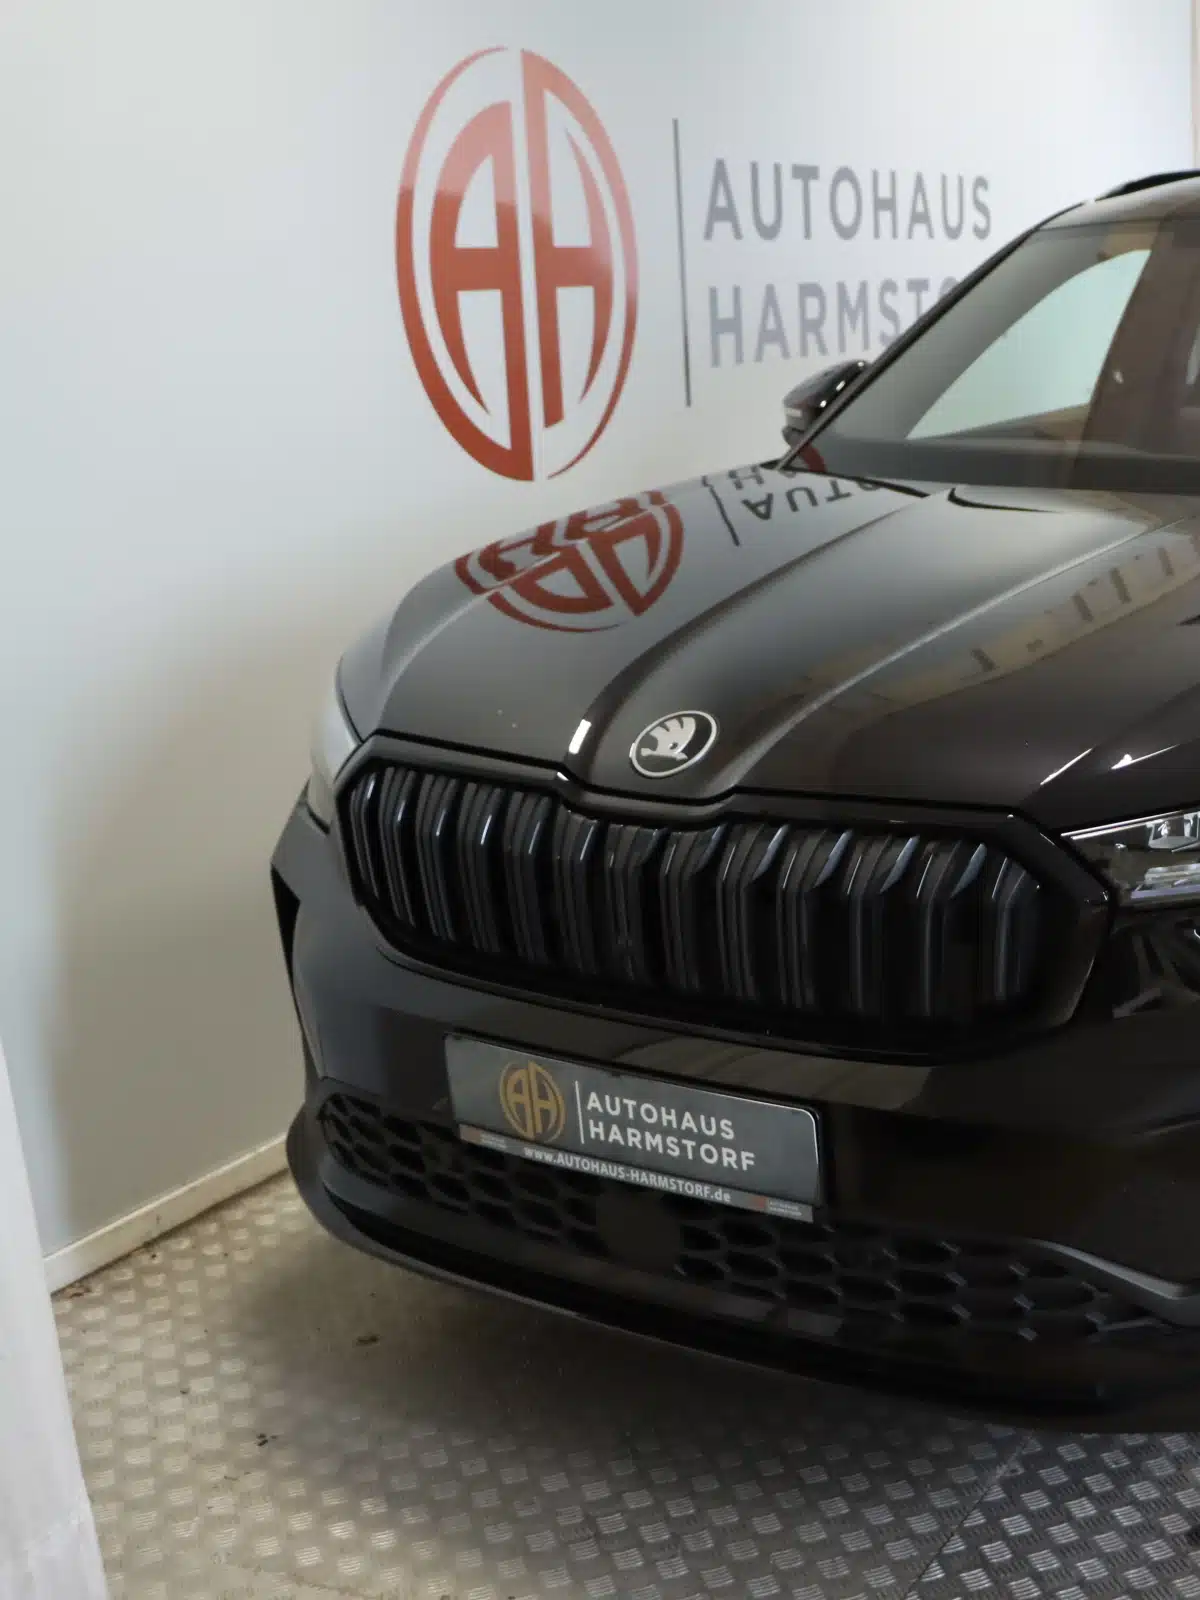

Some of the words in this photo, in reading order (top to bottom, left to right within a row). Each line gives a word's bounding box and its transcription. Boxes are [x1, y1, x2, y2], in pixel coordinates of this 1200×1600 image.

[703, 157, 992, 241] AUTOHAUS
[708, 276, 960, 369] HARMST
[587, 1091, 735, 1140] AUTOHAUS
[523, 1145, 732, 1203] www.AUTOHAUS-HARMSTORF.de
[589, 1119, 756, 1172] HARMSTORF
